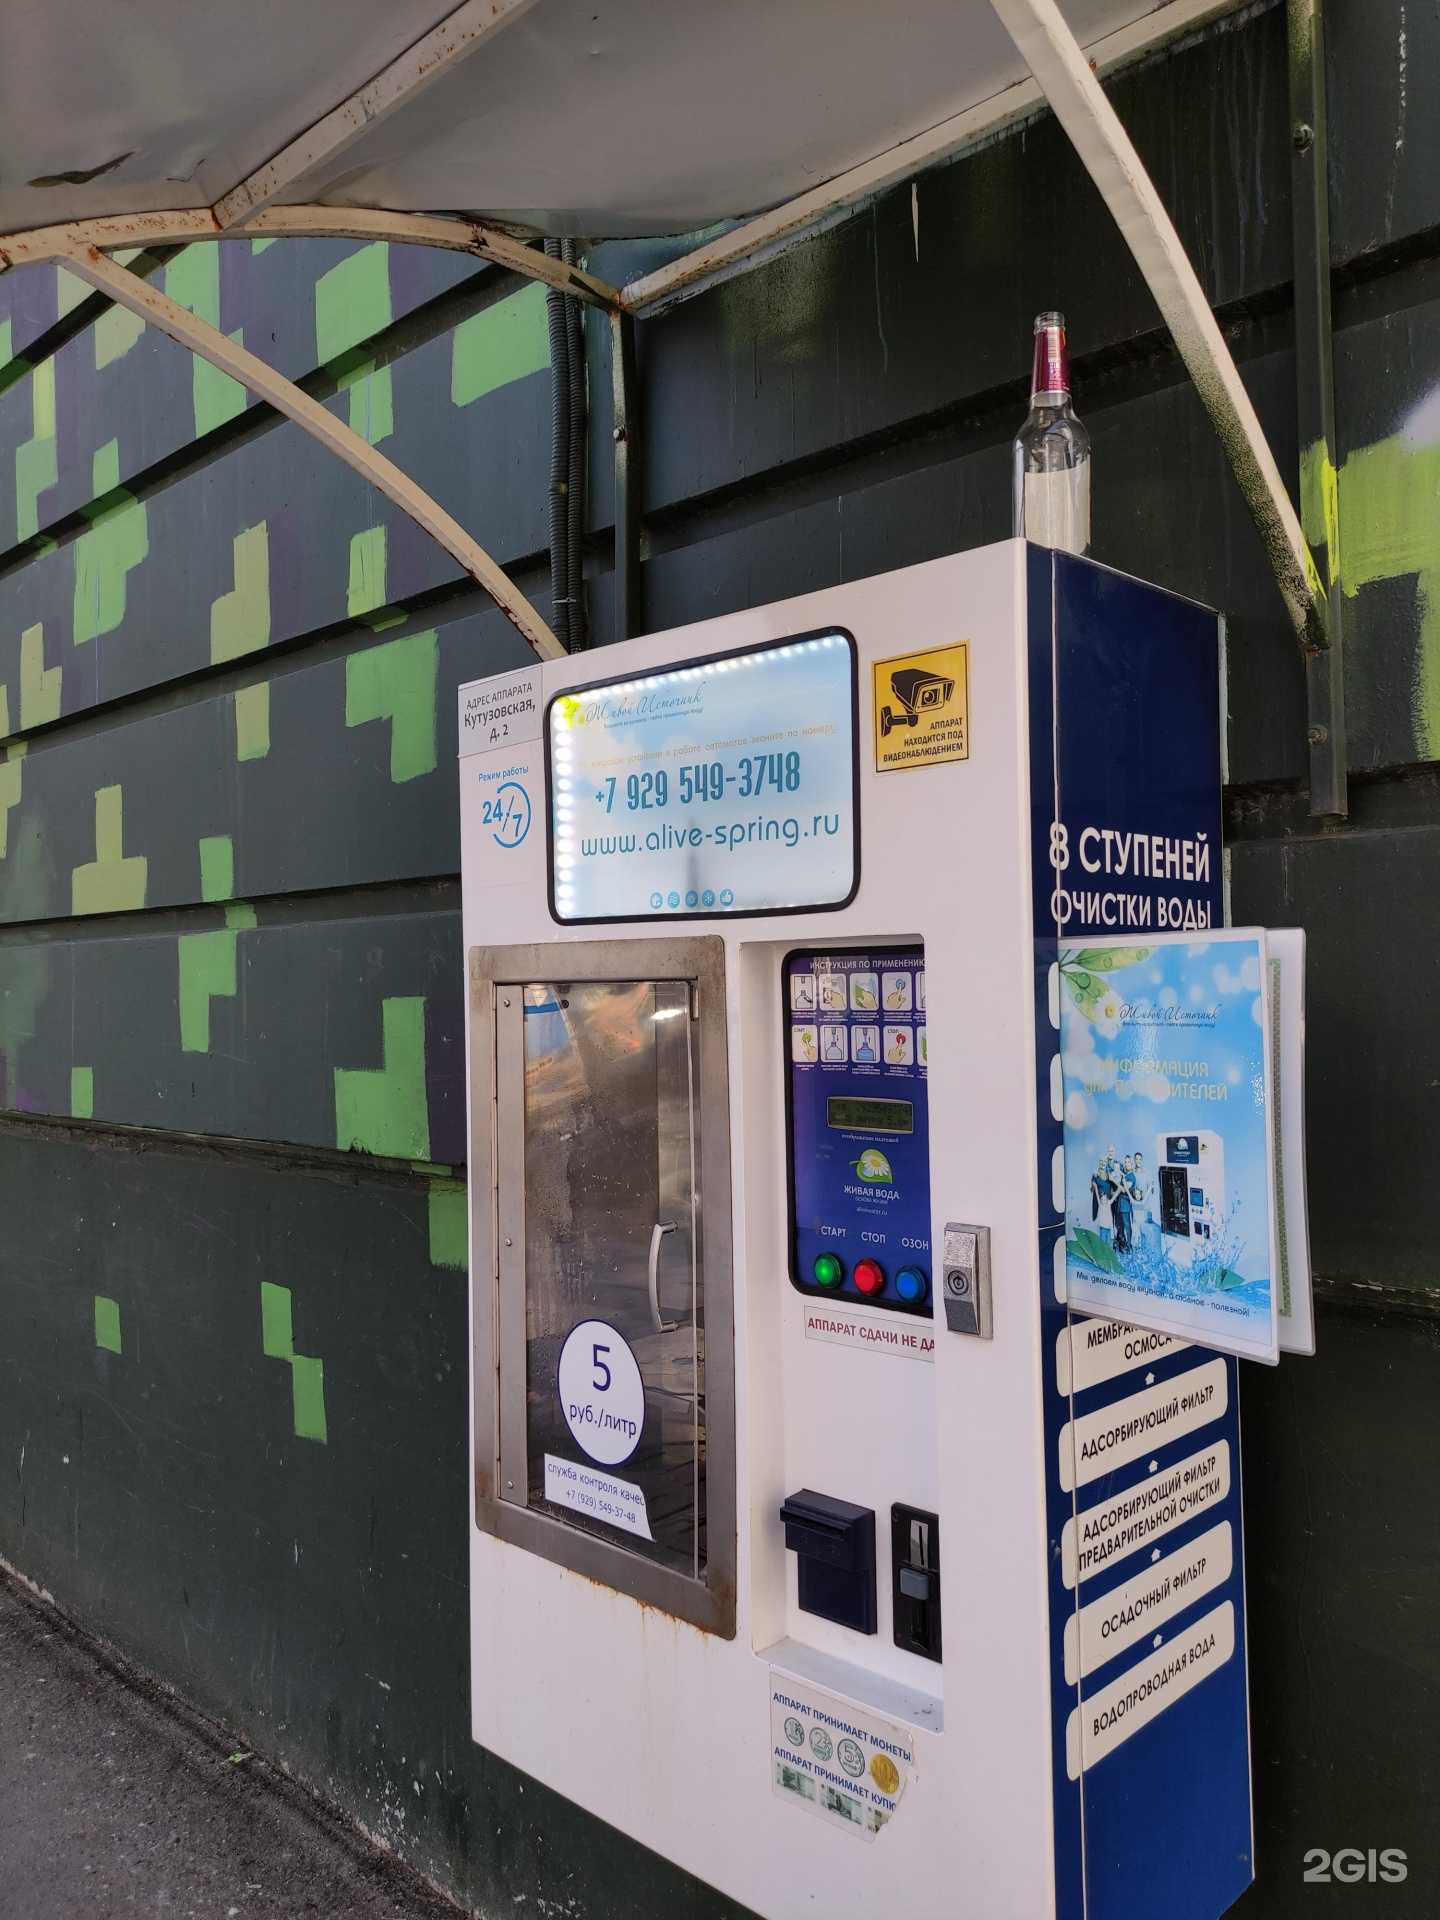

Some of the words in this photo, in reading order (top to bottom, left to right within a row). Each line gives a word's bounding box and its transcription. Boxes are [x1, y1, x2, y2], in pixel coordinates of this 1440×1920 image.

[466, 695, 490, 710] АДРЕС
[492, 682, 533, 703] АППАРАТА
[464, 699, 536, 730] Кутузовская,
[502, 724, 509, 736] 2
[930, 718, 963, 731] АППАРАТ
[883, 742, 963, 763] ВИДЕОНАБЛЮДЕНИЕМ
[904, 733, 946, 747] НАХОДИТСЯ
[947, 730, 963, 740] ПОД
[479, 772, 500, 783] Режим
[502, 766, 529, 781] работы
[595, 777, 617, 814] +7
[627, 770, 668, 810] 929
[680, 751, 800, 804] 549-3748
[482, 795, 523, 838] 24/7
[581, 814, 839, 857] www.alive-spring.ru
[1049, 821, 1070, 871] 8
[1079, 826, 1210, 883] СТУПЕНЕЙ
[1050, 889, 1151, 927] ОЧИСТКИ
[1157, 896, 1211, 932] ВОДЫ
[810, 960, 857, 970] ИНСТРУКЦИЯ
[858, 960, 871, 969] ПО
[844, 1185, 874, 1197] ЖИВАЯ
[875, 1189, 900, 1201] ВОДА
[820, 1226, 846, 1237] СТАРТ
[861, 1231, 886, 1244] СТОП
[901, 1238, 929, 1250] ОЗОН
[808, 1318, 856, 1336] АППАРАТ
[860, 1327, 898, 1345] СДАЧИ
[901, 1334, 917, 1348] НЕ
[1087, 1322, 1137, 1349] МЕМБРА
[592, 1344, 612, 1392] 5
[570, 1403, 637, 1439] руб./литр
[1081, 1397, 1179, 1461] АДСОРБИРУЮЩИЙ
[1180, 1384, 1214, 1412] ФИЛЬТР
[548, 1463, 577, 1481] служба
[579, 1474, 618, 1496] контроля
[566, 1489, 576, 1500] +7
[577, 1492, 597, 1511] (929)
[599, 1499, 636, 1524] 549-37-48
[1083, 1472, 1181, 1542] АДСОРБИРУЮЩИЙ
[1183, 1456, 1216, 1485] ФИЛЬТР
[1079, 1499, 1177, 1572] ПРЕДВАРИТЕЛЬНОЙ
[1179, 1477, 1220, 1514] ОЧИСТКИ
[1101, 1578, 1170, 1639] ОСАДОЧНЫЙ
[1172, 1558, 1207, 1591] ФИЛЬТР
[1093, 1655, 1187, 1737] ВОДОПРОВОДНАЯ
[1189, 1634, 1215, 1664] ВОДА
[773, 1692, 811, 1715] АППАРАТ
[813, 1709, 868, 1742] ПРИНИМАЕТ
[870, 1735, 912, 1762] МОНЕТЫ
[774, 1747, 812, 1770] АППАРАТ
[814, 1766, 869, 1799] ПРИНИМАЕТ
